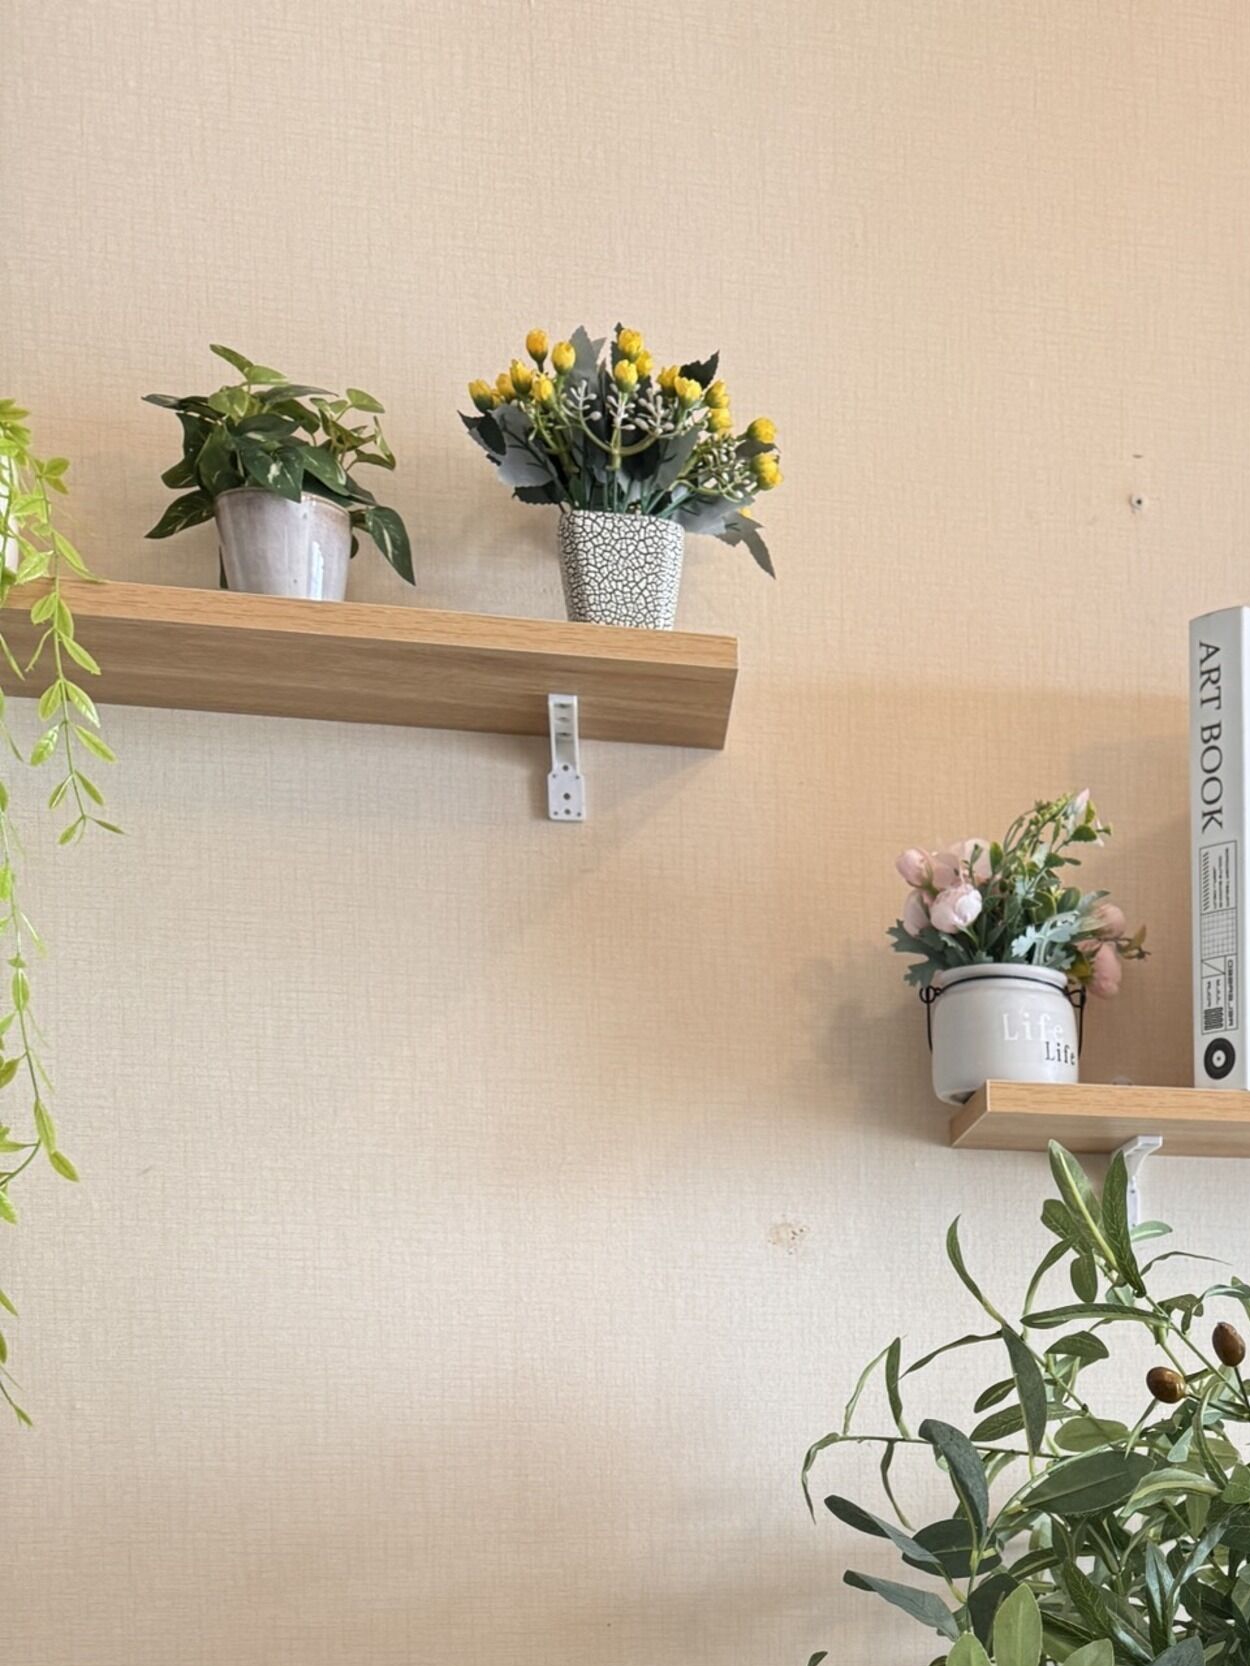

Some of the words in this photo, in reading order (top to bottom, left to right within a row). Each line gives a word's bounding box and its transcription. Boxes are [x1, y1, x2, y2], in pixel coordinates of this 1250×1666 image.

[1198, 640, 1222, 711] ART
[1199, 721, 1224, 835] BOOK
[1002, 1012, 1065, 1042] Life
[1044, 1041, 1077, 1066] Life
